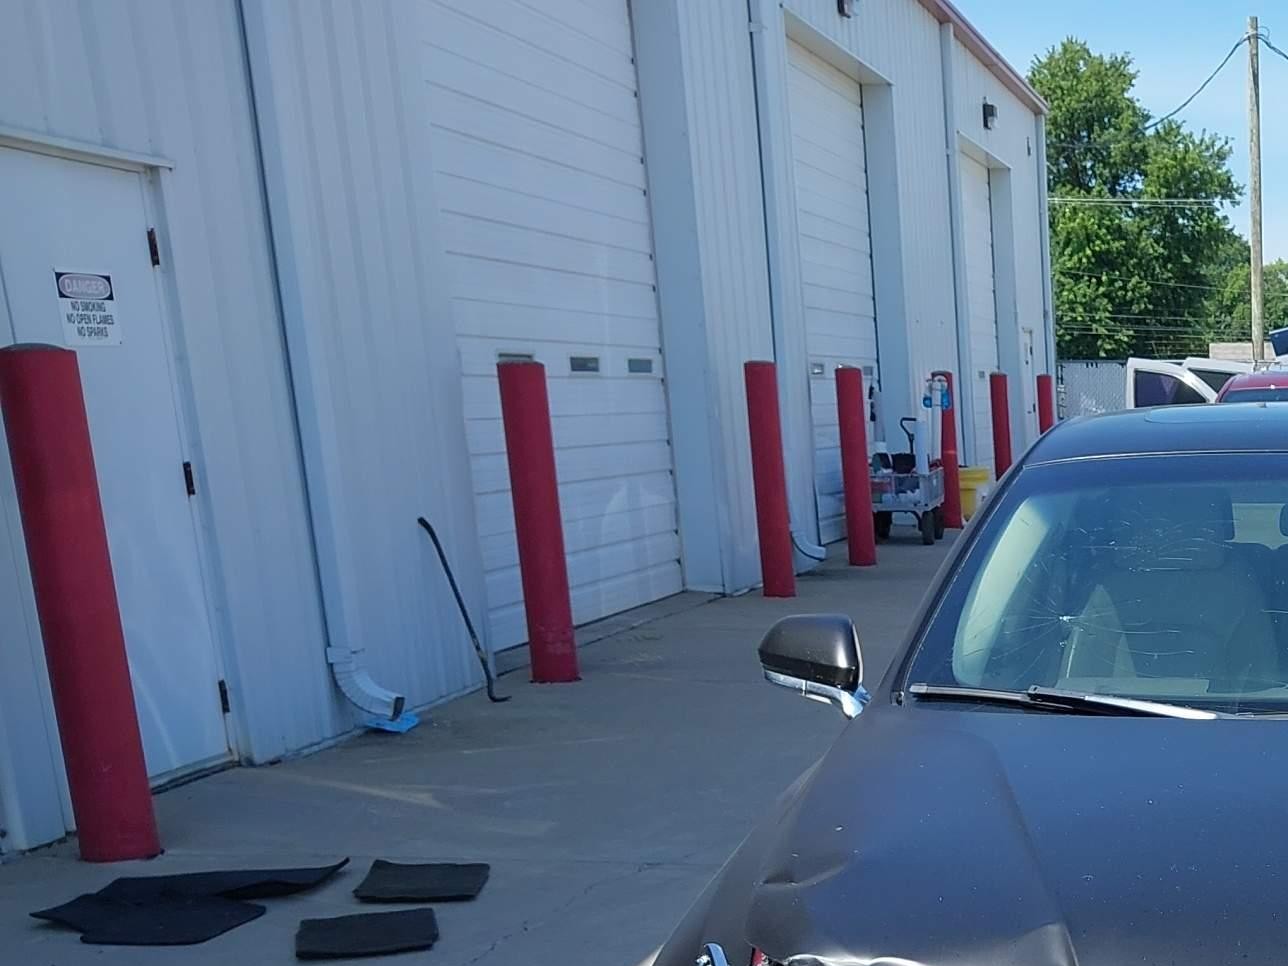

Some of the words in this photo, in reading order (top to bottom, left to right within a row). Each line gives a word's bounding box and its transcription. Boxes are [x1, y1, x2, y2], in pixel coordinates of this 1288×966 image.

[64, 278, 107, 294] DANGER
[71, 301, 80, 312] NO
[80, 301, 106, 312] SMOKING
[66, 313, 75, 325] NO
[76, 313, 92, 325] OPEN
[92, 314, 114, 325] FLAMES
[77, 326, 86, 337] NO
[86, 326, 108, 337] SPARKS
